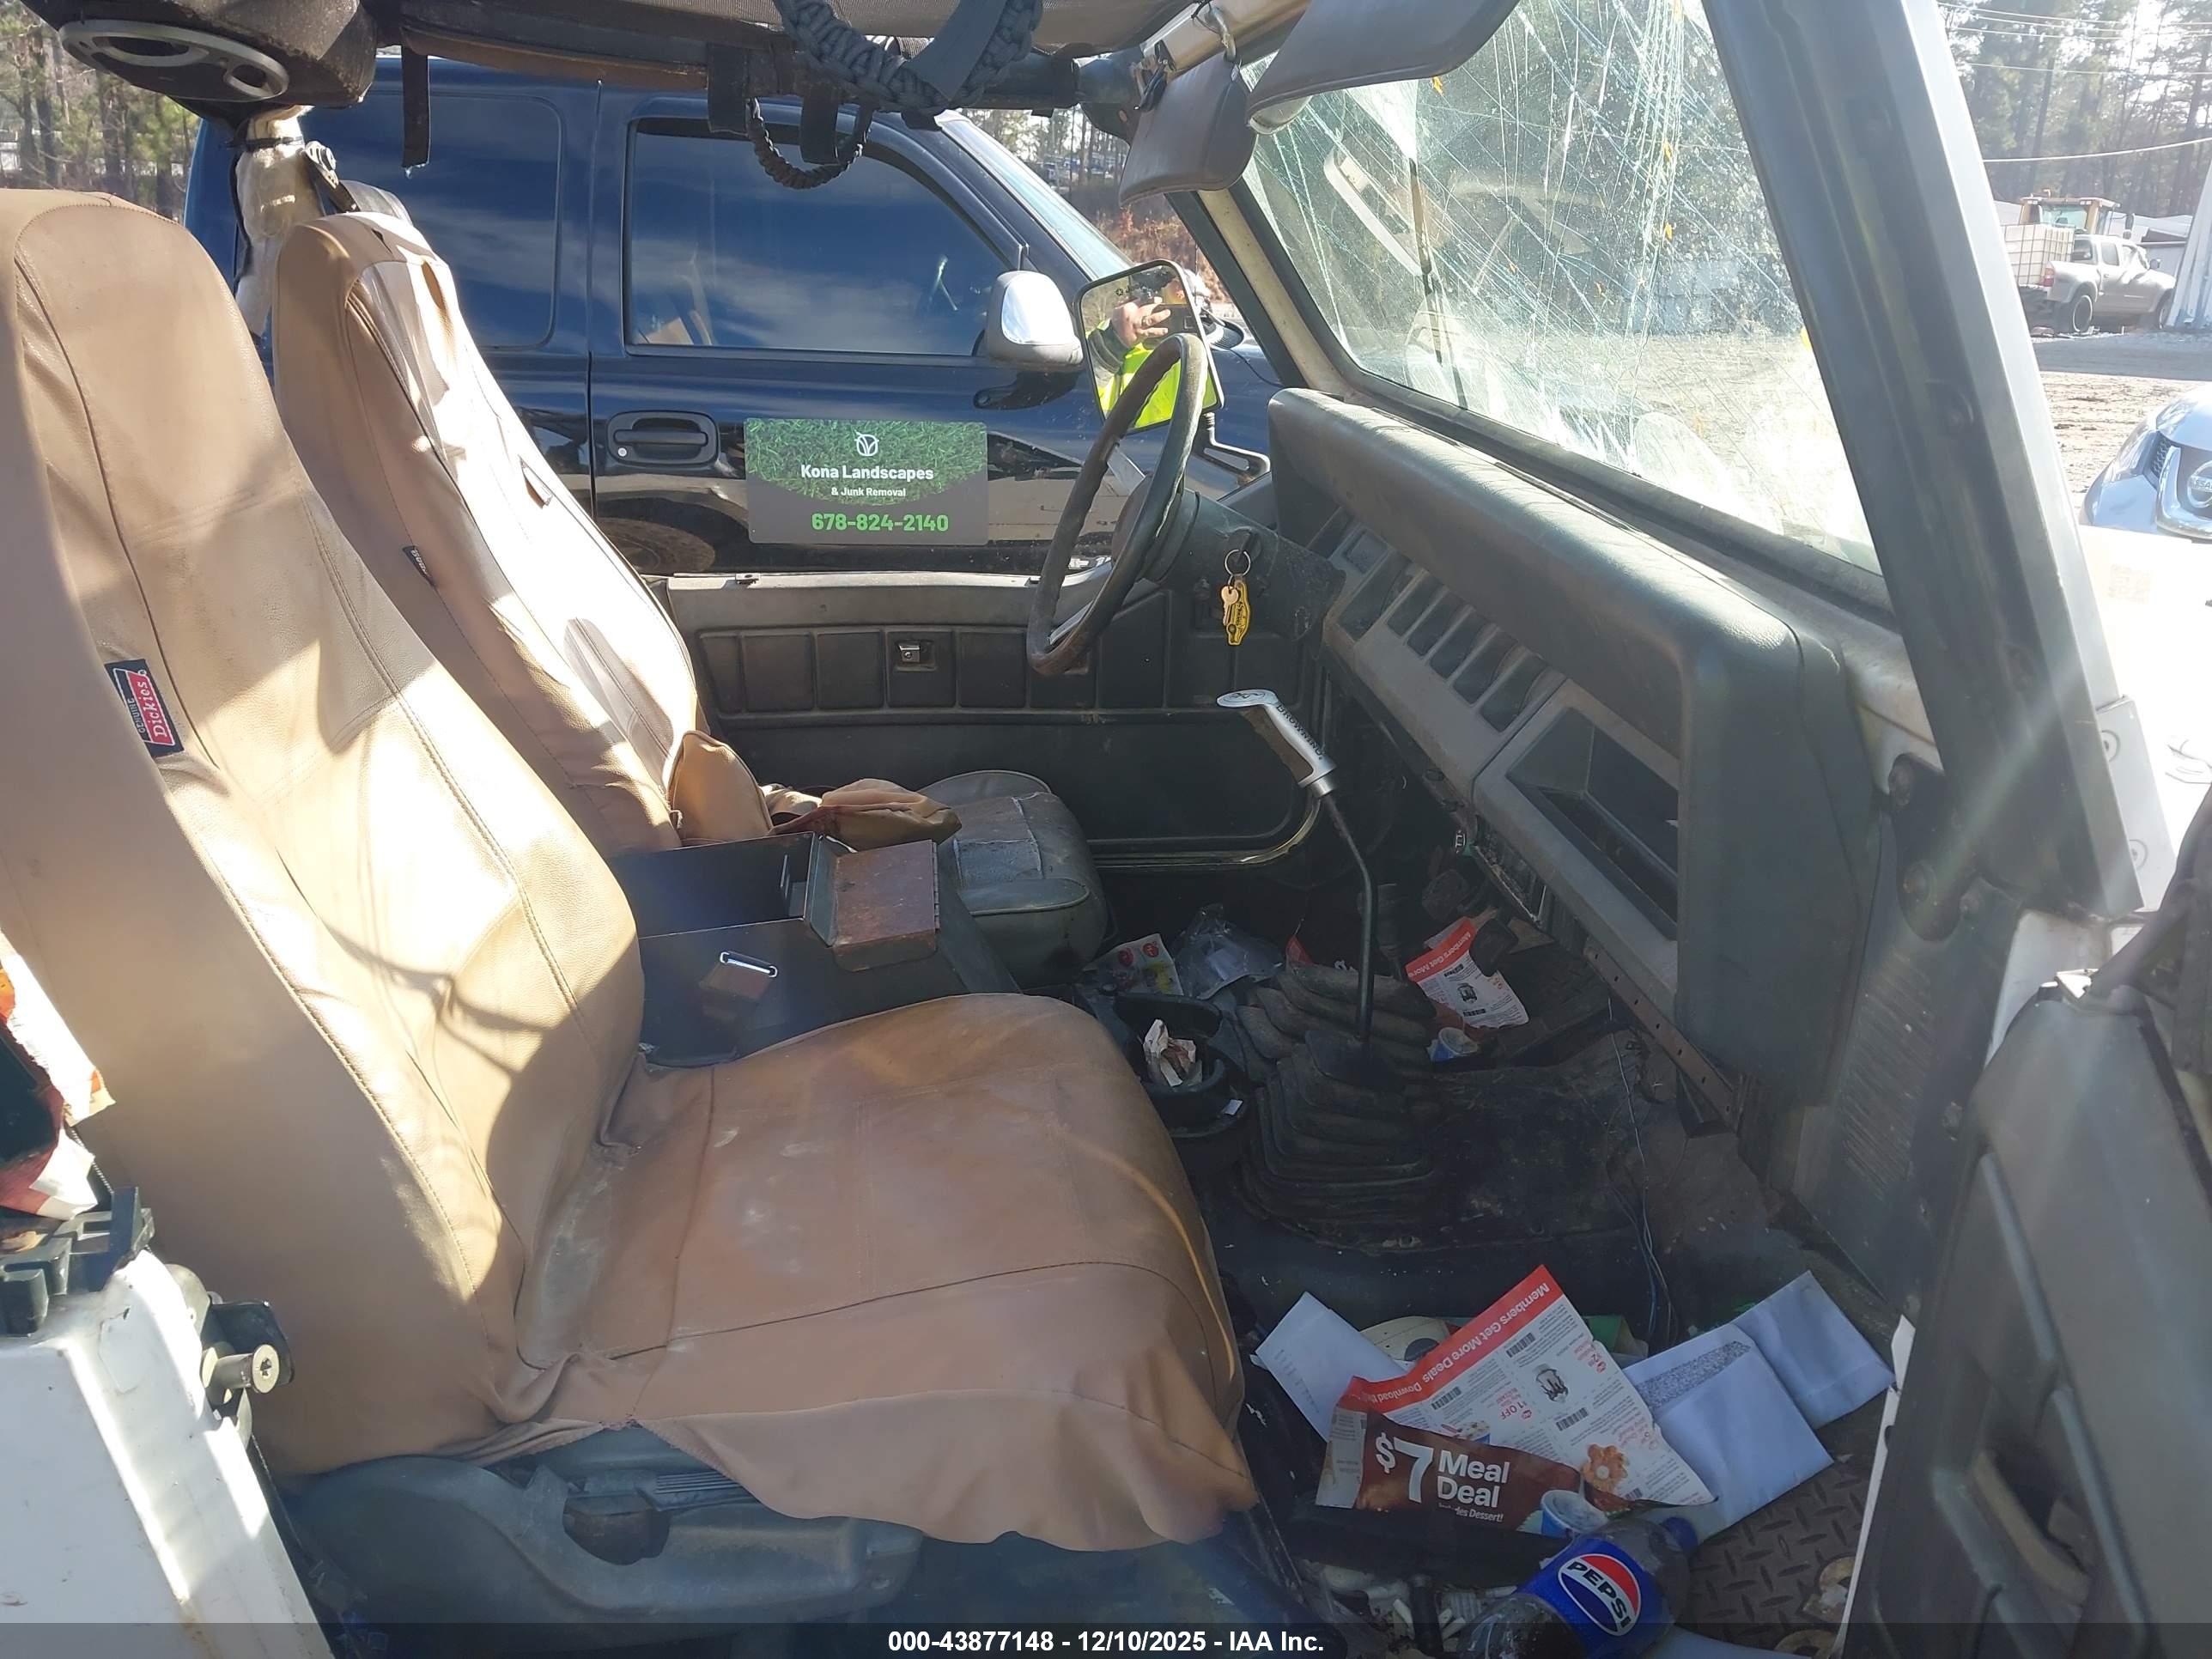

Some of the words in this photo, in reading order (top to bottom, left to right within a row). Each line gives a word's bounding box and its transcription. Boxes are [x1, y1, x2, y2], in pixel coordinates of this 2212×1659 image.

[800, 464, 840, 479] Kona
[842, 465, 934, 481] Landscapes
[831, 487, 839, 496] &
[841, 487, 864, 496] Junk
[866, 488, 907, 497] Removal
[811, 513, 949, 532] 678-824-2140
[127, 697, 146, 733] GENUINE
[137, 681, 167, 738] Dickies
[1444, 931, 1471, 958] Members
[1430, 956, 1444, 968] Get
[1501, 1282, 1550, 1325] Members
[1480, 1323, 1503, 1340] Get
[1451, 1338, 1483, 1361] More
[1422, 1358, 1454, 1383] Deals
[1377, 1381, 1423, 1402] Download
[1375, 1431, 1435, 1504] $7
[1438, 1449, 1510, 1484] Meal
[1437, 1475, 1500, 1508] Deal
[1469, 1509, 1504, 1523] Dessert!
[1566, 1561, 1632, 1628] PEPSI
